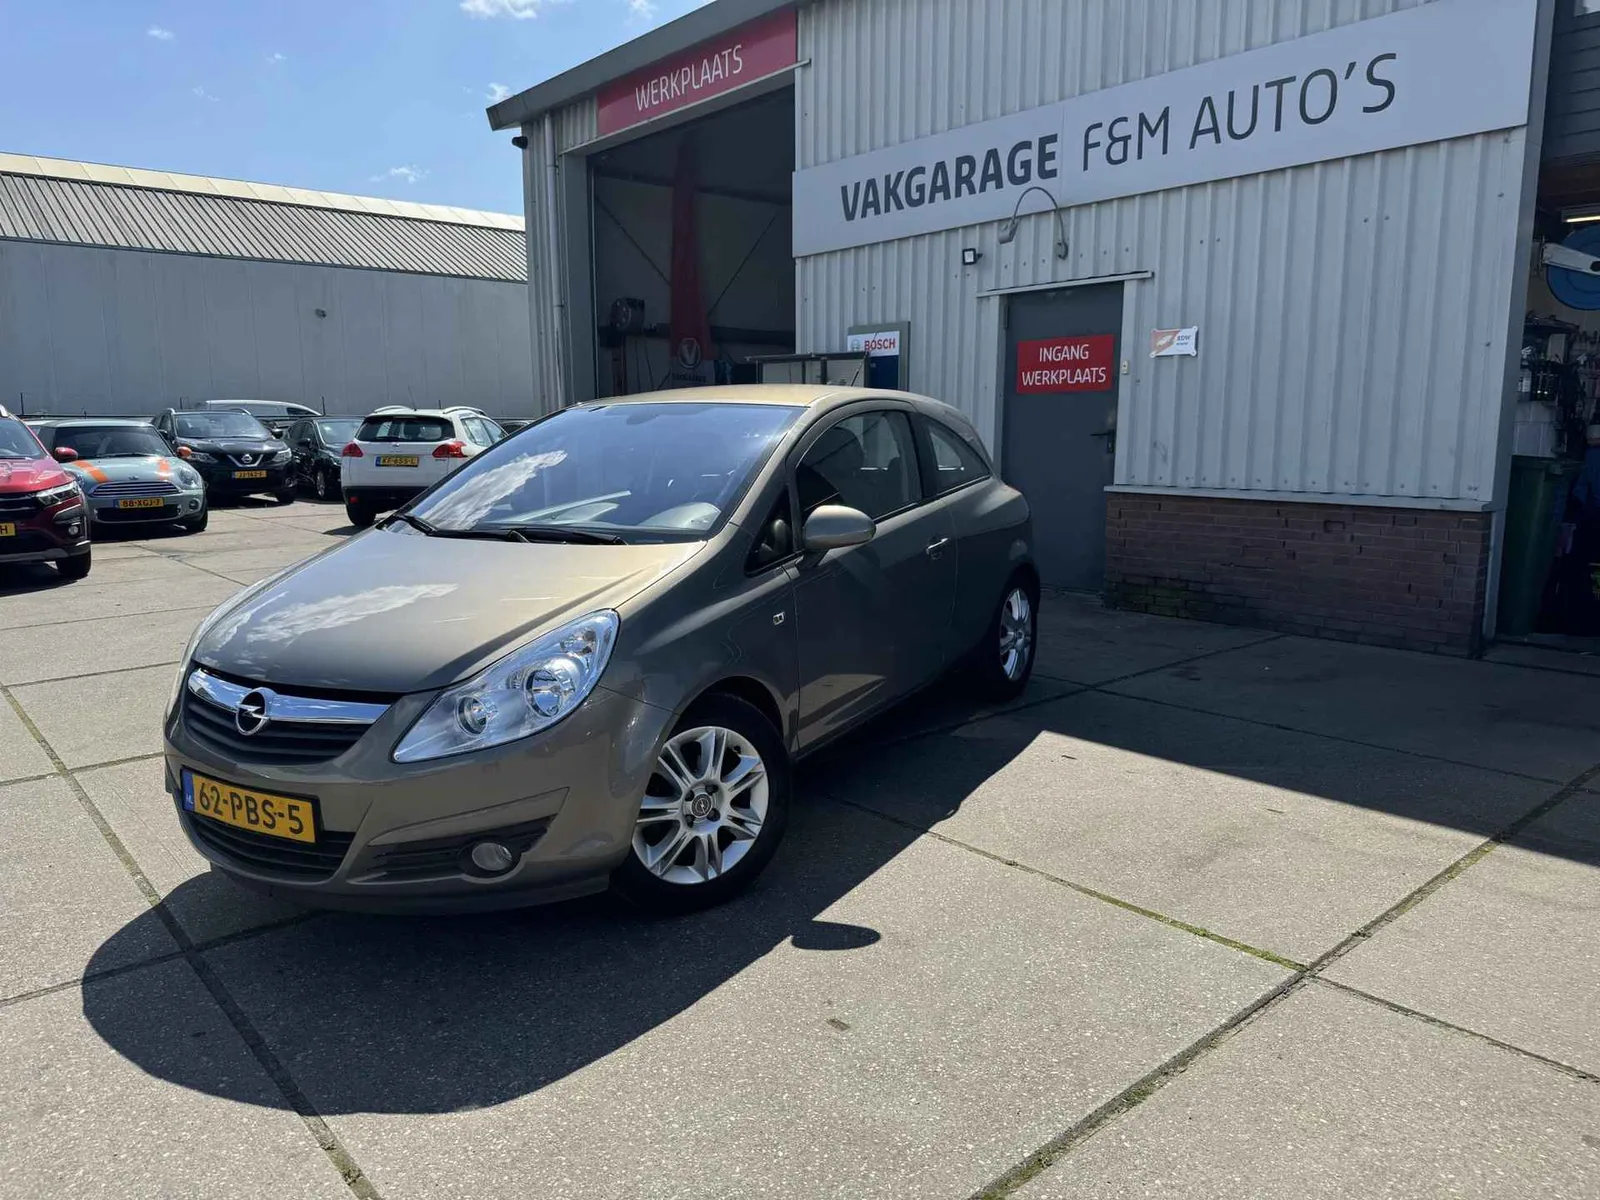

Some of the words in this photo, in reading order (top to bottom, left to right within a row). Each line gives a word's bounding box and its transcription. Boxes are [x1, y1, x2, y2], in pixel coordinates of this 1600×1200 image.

[635, 44, 743, 112] WERKPLAATS
[840, 132, 1059, 221] VAKGARAGE
[1082, 106, 1171, 171] F&M
[1188, 52, 1398, 149] AUTO'S
[864, 338, 896, 350] BOSCH
[1039, 344, 1089, 362] INGANG
[1021, 367, 1106, 386] WERKPLAATS
[199, 782, 304, 835] 62-PBS-5
